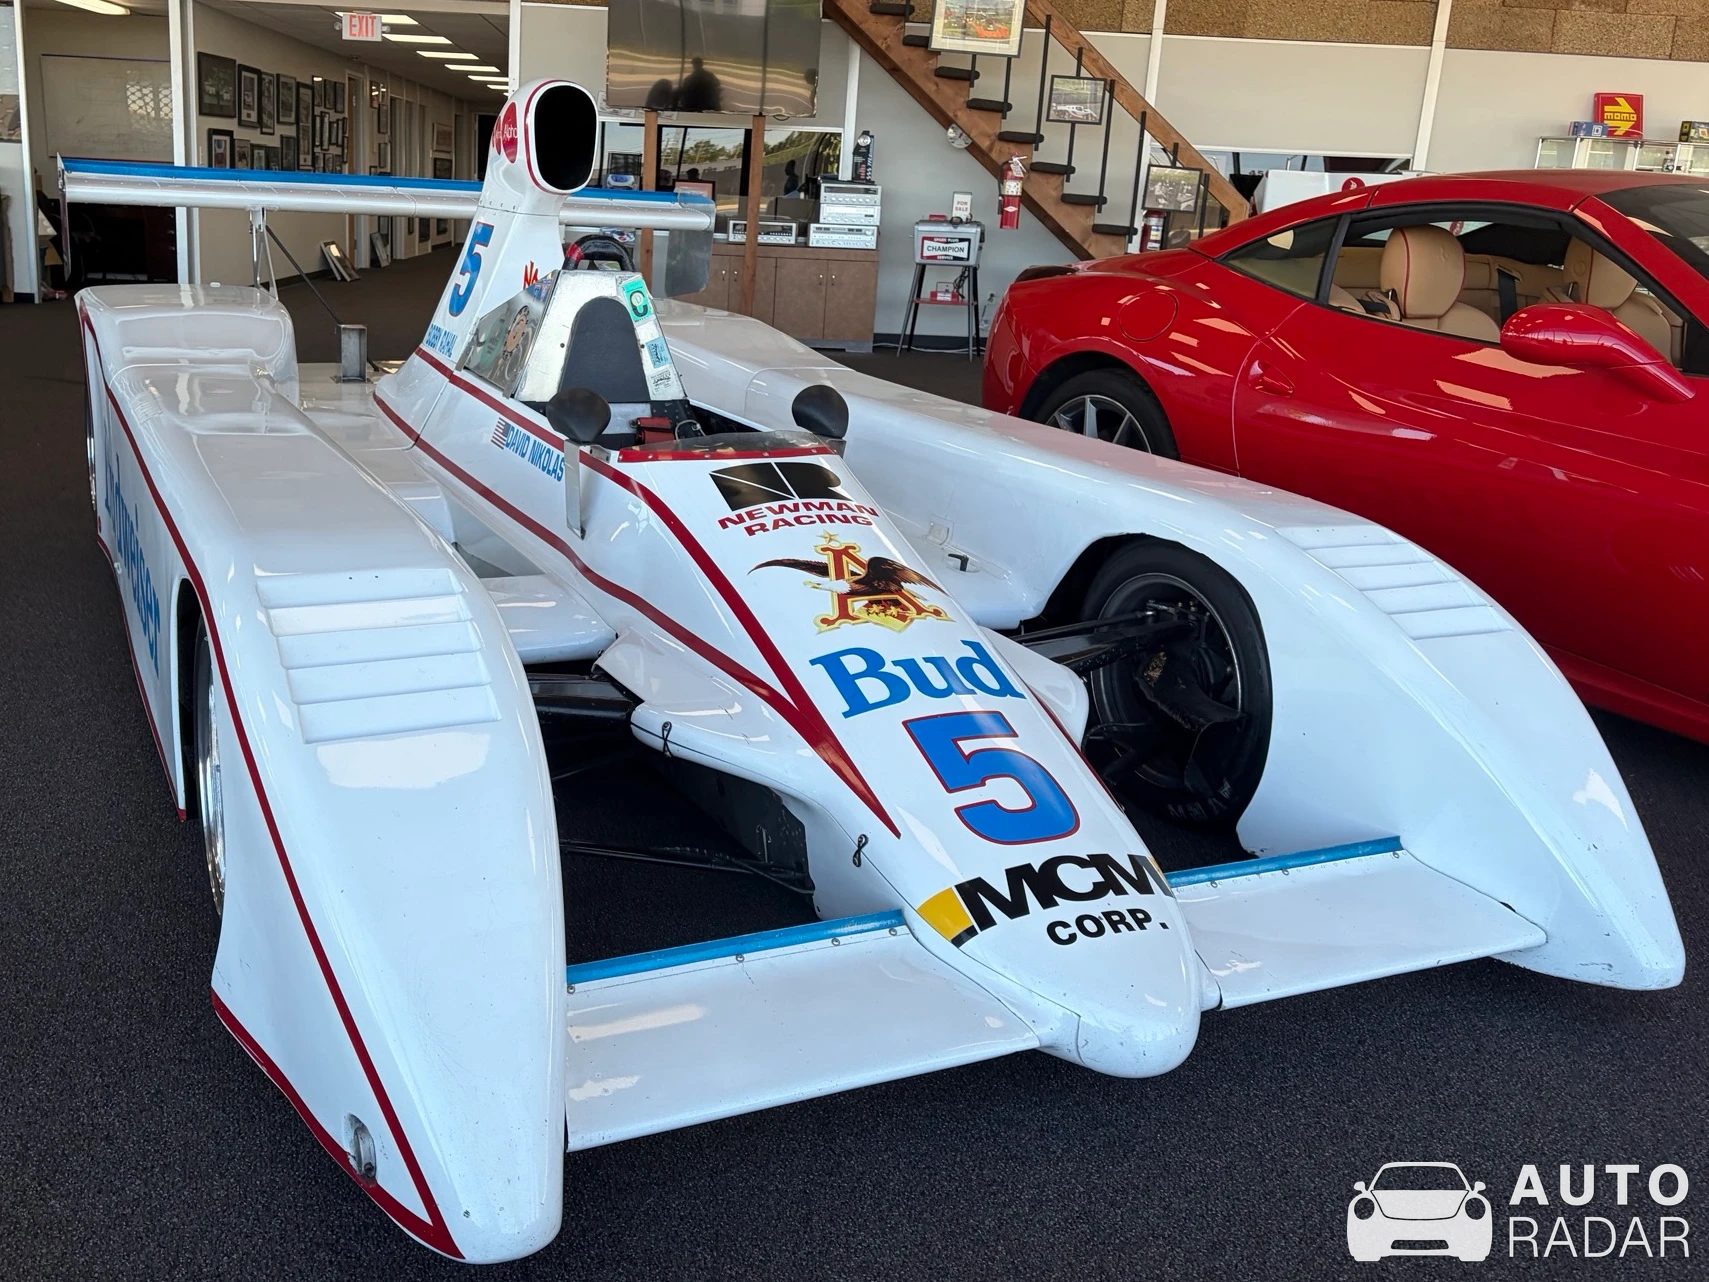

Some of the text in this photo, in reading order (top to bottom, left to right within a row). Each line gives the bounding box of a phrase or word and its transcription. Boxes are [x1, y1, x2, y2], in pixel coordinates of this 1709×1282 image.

[349, 14, 376, 37] EXIT
[448, 221, 495, 317] 5
[926, 245, 965, 253] CHAMPION
[504, 425, 566, 482] DAVID NIKOLAS
[717, 501, 880, 530] NEWMAN
[743, 514, 873, 537] RACING
[808, 639, 1028, 719] Bud
[901, 710, 1081, 846] 5
[954, 853, 1175, 933] MCM
[1046, 908, 1170, 946] CORP.
